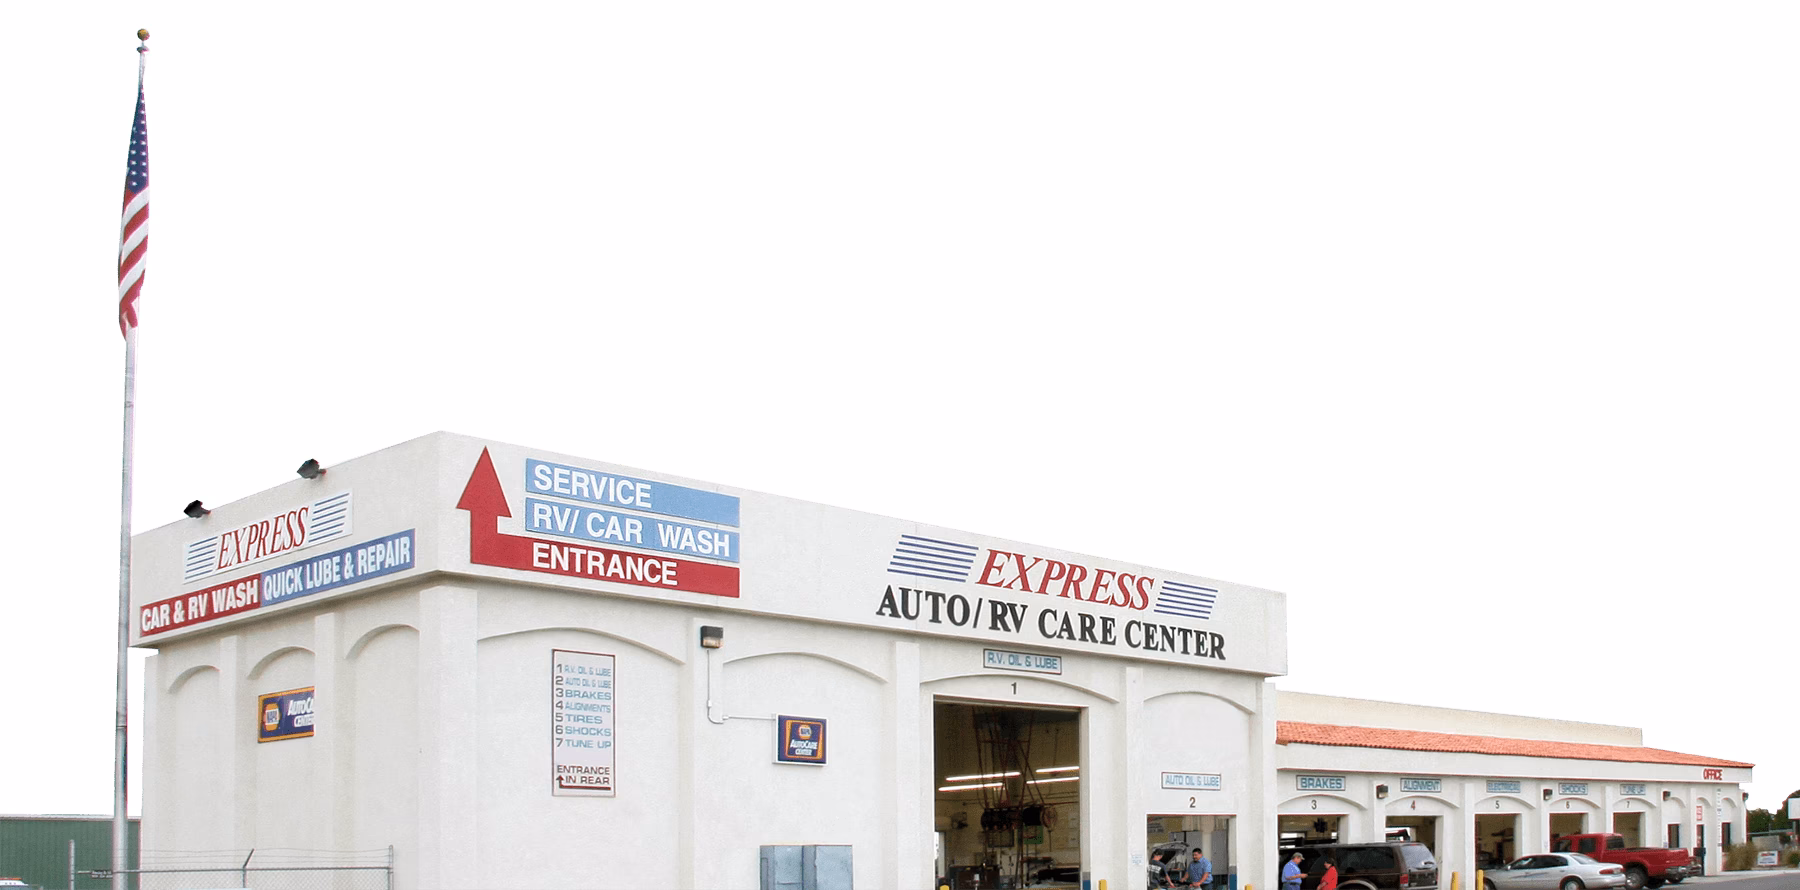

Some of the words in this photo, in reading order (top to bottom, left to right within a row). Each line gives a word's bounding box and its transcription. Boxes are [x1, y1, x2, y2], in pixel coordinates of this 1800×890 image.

[534, 465, 652, 509] SERVICE
[533, 503, 579, 534] RV/
[586, 513, 643, 544] CAR
[658, 523, 730, 557] WASH
[216, 506, 309, 570] EXPRESS
[263, 566, 303, 601] QUICK
[306, 555, 341, 590] LUBE
[344, 552, 355, 579] &
[357, 536, 411, 576] REPAIR
[532, 542, 678, 586] ENTRANCE
[975, 549, 1155, 612] EXPRESS
[141, 607, 170, 632] CAR
[173, 600, 184, 624] &
[188, 594, 208, 618] RV
[211, 578, 258, 614] WASH
[1038, 608, 1117, 646] CARE
[1124, 619, 1226, 660] CENTER
[1008, 654, 1022, 666] OIL
[1025, 655, 1032, 667] &
[1035, 657, 1058, 669] LUBE
[556, 664, 562, 673] 1
[578, 666, 587, 675] OIL
[596, 668, 611, 677] LUBE
[555, 675, 564, 686] 2
[565, 678, 580, 686] AUTO
[555, 688, 564, 698] 3
[565, 689, 612, 700] BRAKES
[1011, 682, 1017, 695] 1
[555, 700, 564, 710] 4
[565, 702, 611, 713] ALIGNMENTS
[555, 713, 564, 723] 5
[565, 714, 603, 724] TIRES
[555, 725, 564, 735] 6
[565, 726, 612, 737] SHOCKS
[556, 738, 564, 748] 7
[565, 739, 594, 748] TUNE
[597, 740, 612, 749] UP
[557, 765, 610, 775] ENTRANCE
[1703, 768, 1723, 780] OFFICE
[565, 775, 577, 784] IN
[580, 776, 610, 785] REAR
[1165, 775, 1183, 785] AUTO
[1300, 777, 1342, 789] BRAKES
[1402, 780, 1440, 791] ALIGNMENT
[1189, 796, 1196, 808] 2
[1311, 799, 1317, 810] 3
[1410, 800, 1416, 810] 4
[1495, 800, 1500, 809] 5
